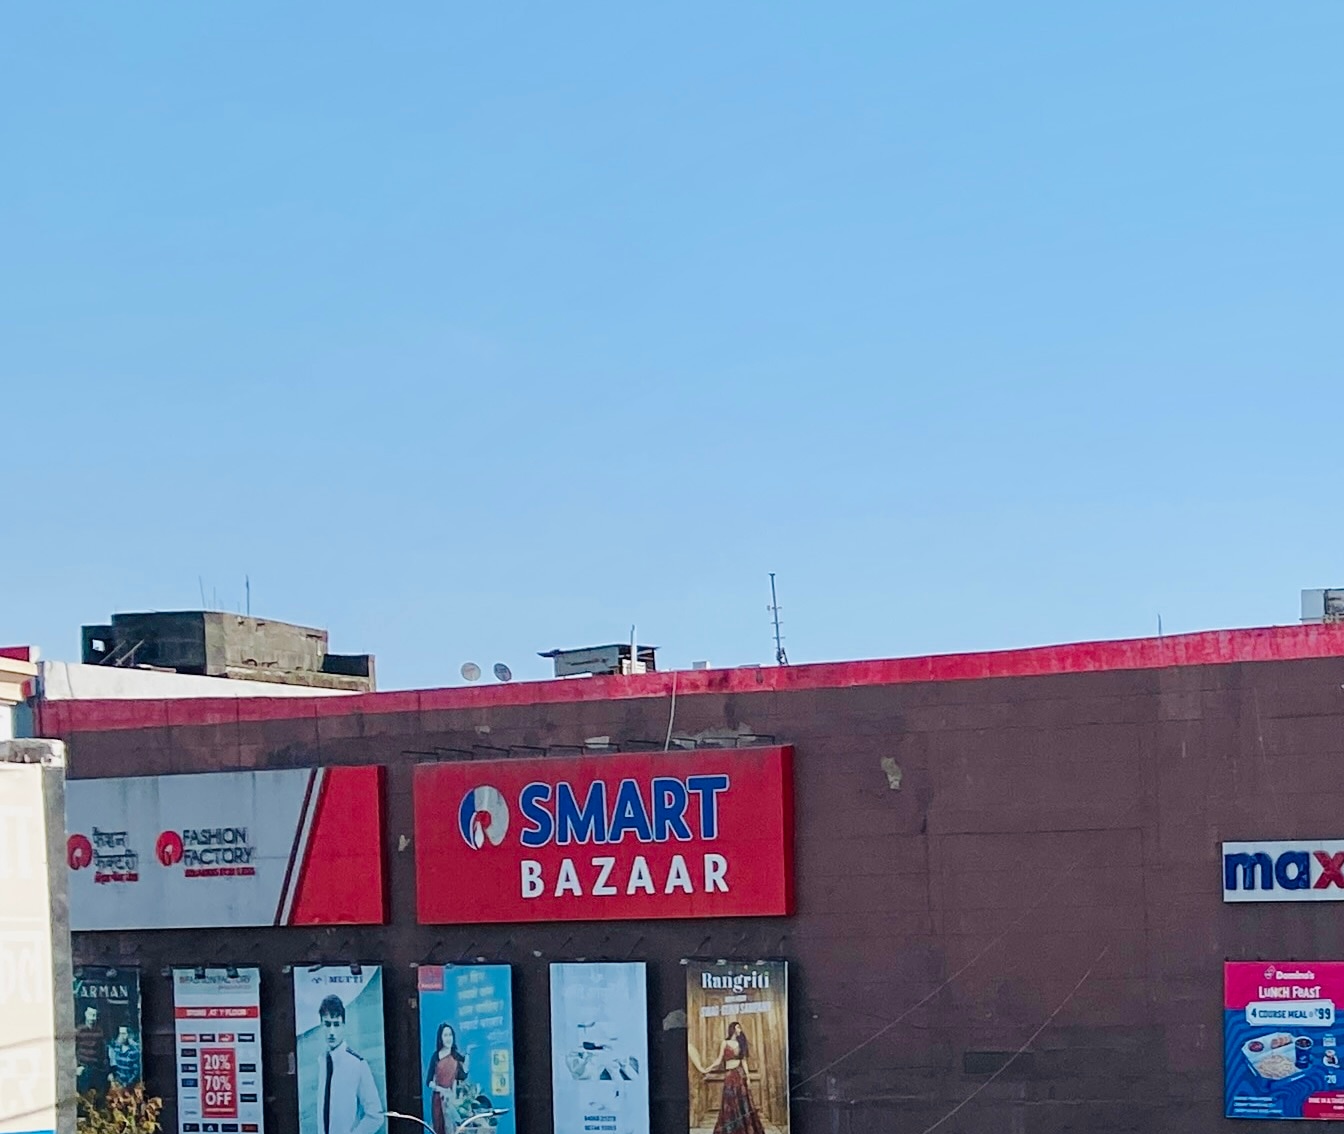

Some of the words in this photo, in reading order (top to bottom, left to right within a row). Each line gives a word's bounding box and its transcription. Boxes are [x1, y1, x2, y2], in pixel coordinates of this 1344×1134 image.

[519, 774, 731, 847] SMART
[183, 827, 248, 846] FASHION
[184, 847, 254, 866] FACTORY
[520, 853, 731, 899] BAZAAR
[701, 970, 771, 993] Rangriti
[1259, 985, 1290, 998] LUNCH
[1251, 1008, 1257, 1018] 4
[1258, 1009, 1286, 1018] COURSE
[1288, 1009, 1308, 1018] MEAL
[203, 1054, 231, 1070] 20%
[204, 1075, 232, 1091] 70%
[205, 1092, 232, 1106] OFF
